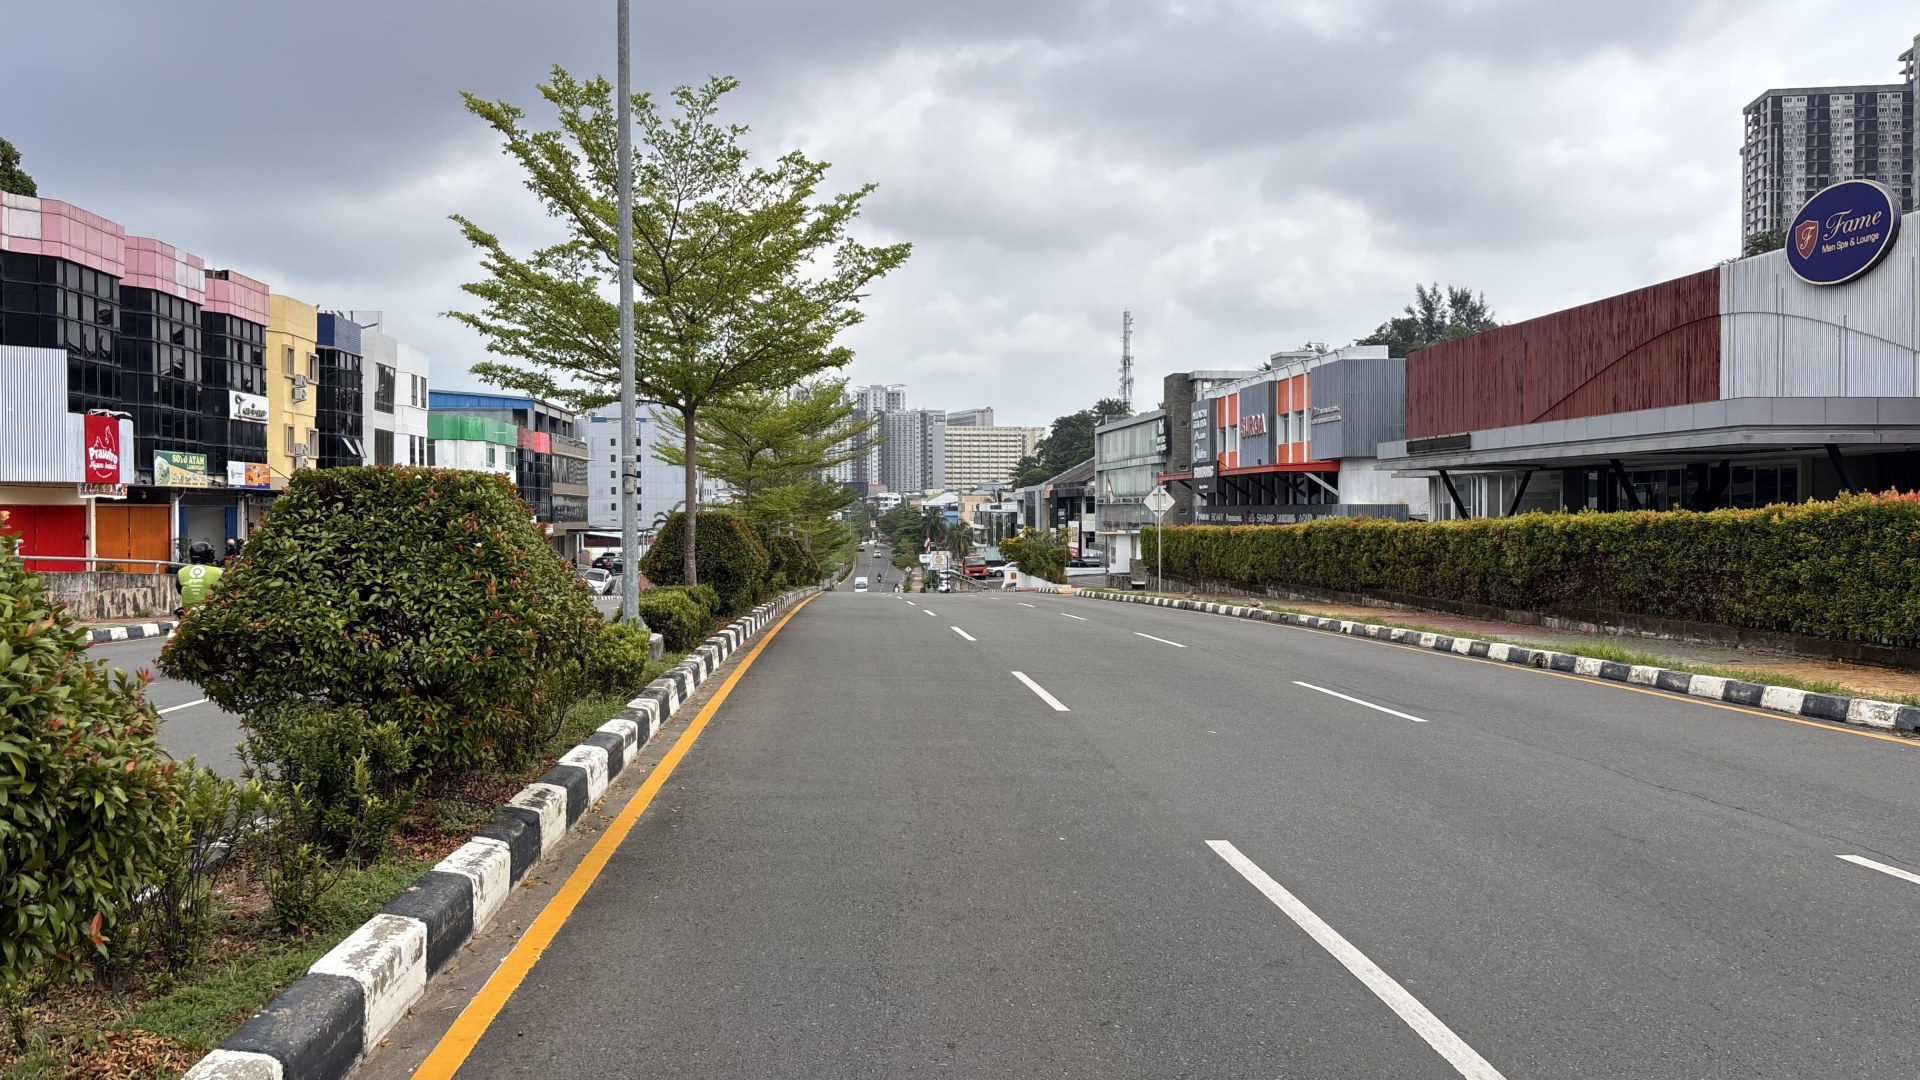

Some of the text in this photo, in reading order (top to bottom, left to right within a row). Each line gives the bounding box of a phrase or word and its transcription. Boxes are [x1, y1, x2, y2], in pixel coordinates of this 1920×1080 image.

[1823, 209, 1882, 241] Fame
[1800, 225, 1816, 250] F
[1822, 232, 1880, 254] Men Spa & Lounge
[89, 447, 118, 465] Prawiro
[1256, 513, 1276, 523] SHARP
